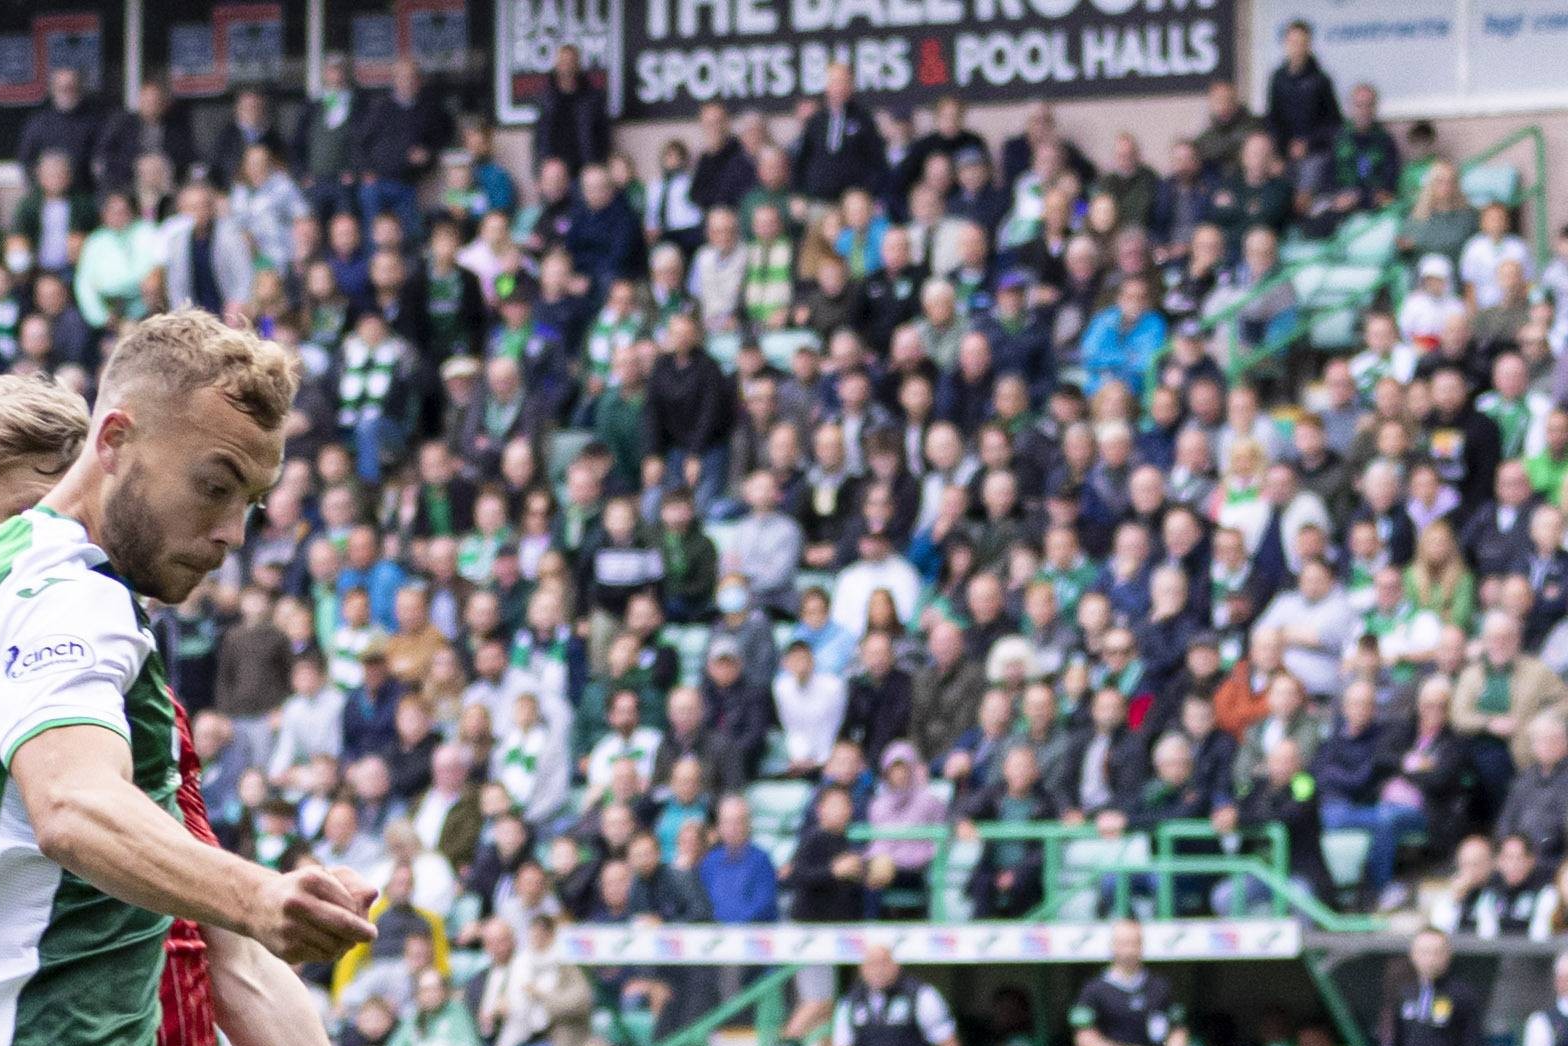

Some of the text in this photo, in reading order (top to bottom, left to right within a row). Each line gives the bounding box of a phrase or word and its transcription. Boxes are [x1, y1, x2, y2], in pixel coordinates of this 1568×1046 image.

[512, 36, 610, 71] ROM
[638, 46, 796, 103] SPORTS
[955, 28, 1078, 87] POOL
[1082, 19, 1220, 80] HALLS
[22, 641, 85, 668] cinch
